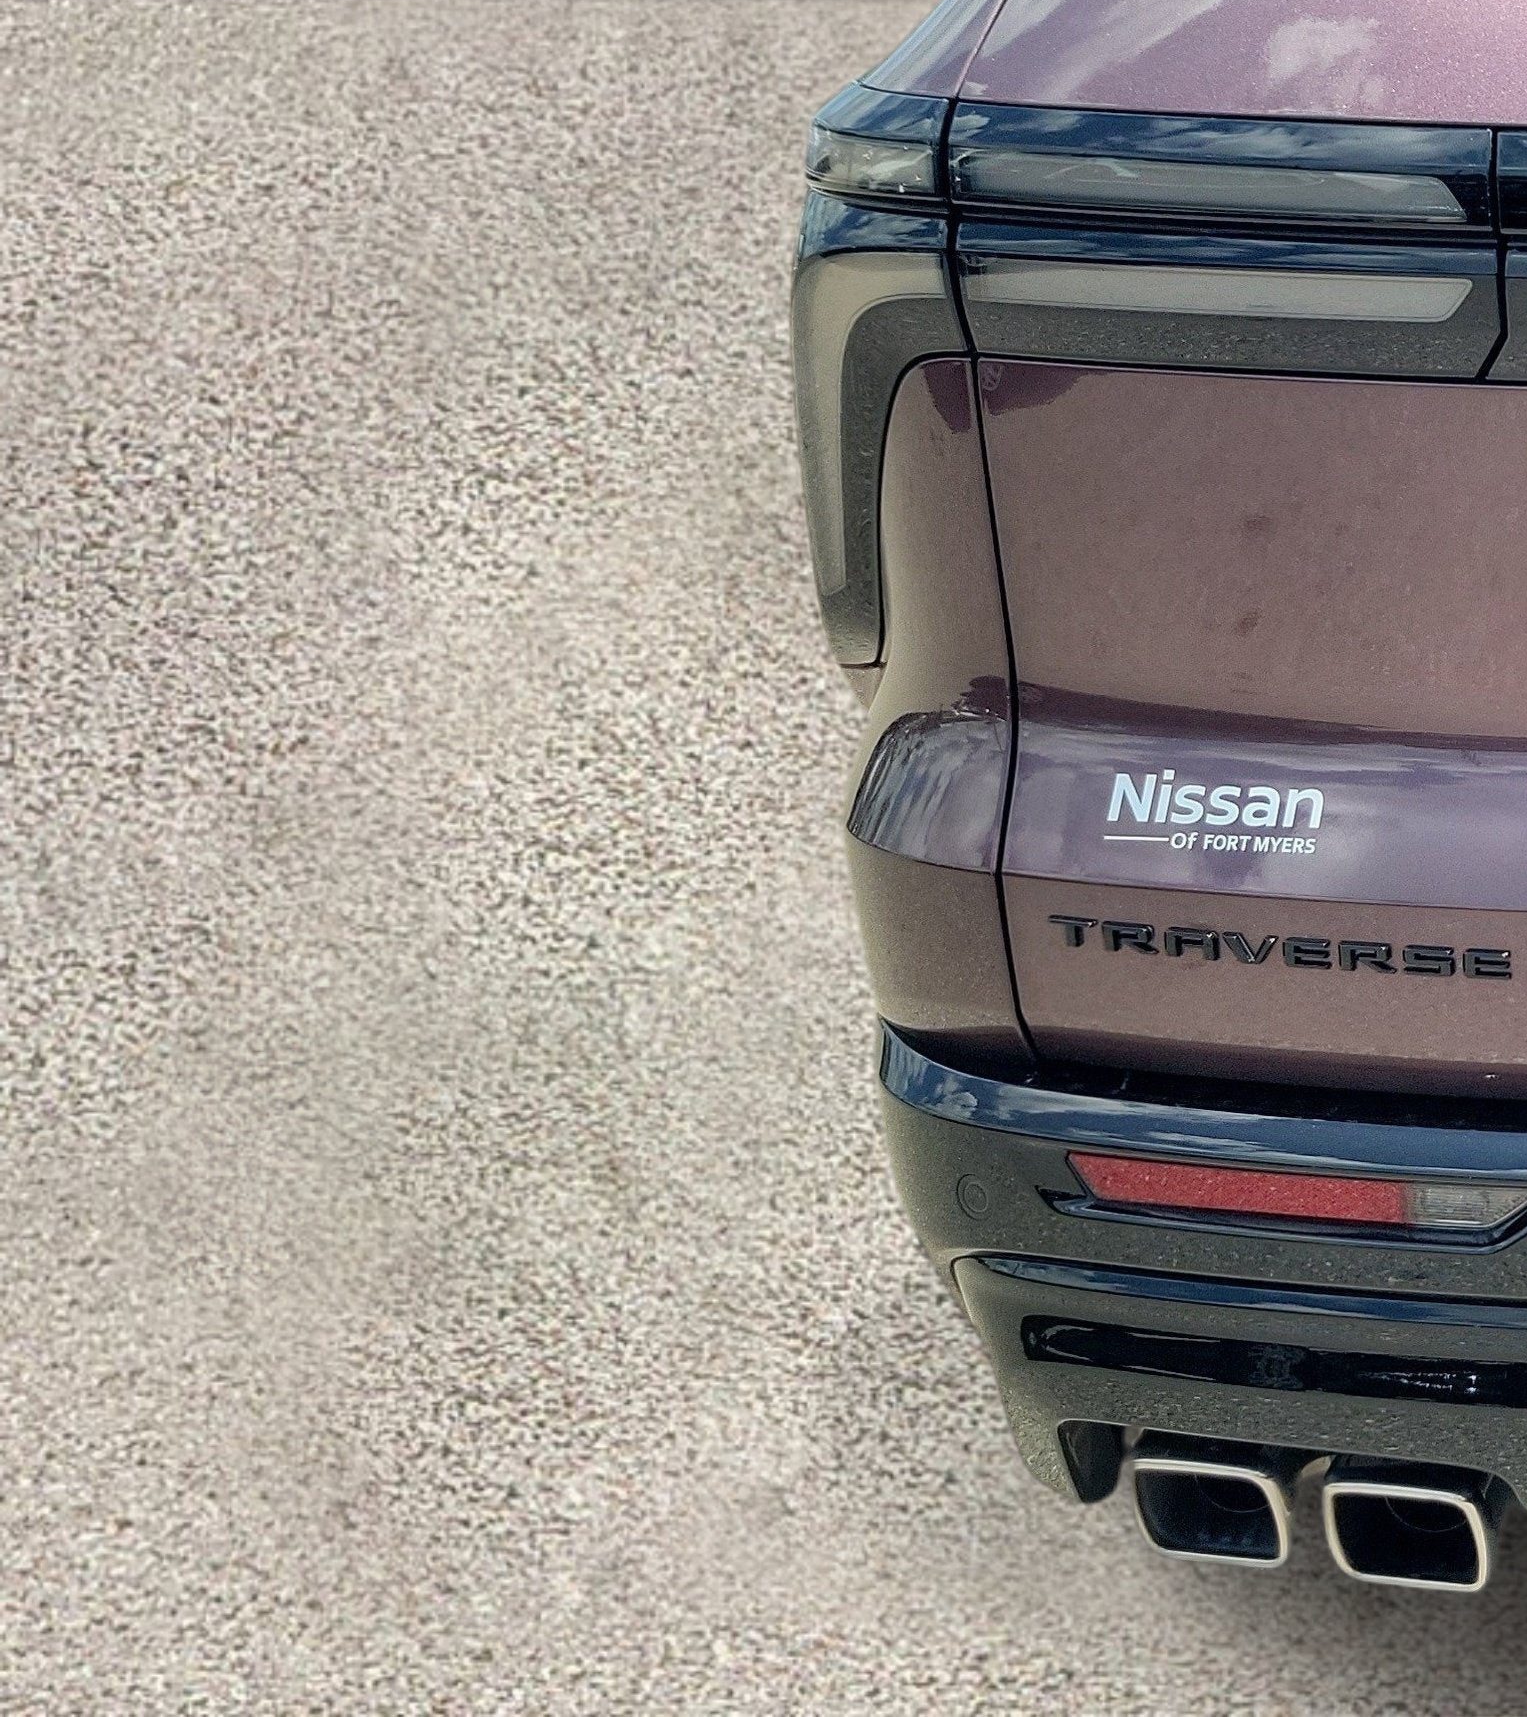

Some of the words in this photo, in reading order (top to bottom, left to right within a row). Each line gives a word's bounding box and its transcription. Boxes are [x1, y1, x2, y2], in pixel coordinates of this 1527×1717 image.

[1106, 768, 1324, 829] Nissan
[1203, 834, 1252, 852] FORT
[1253, 836, 1316, 854] MYERS
[1048, 914, 1513, 980] TRAVERSE
